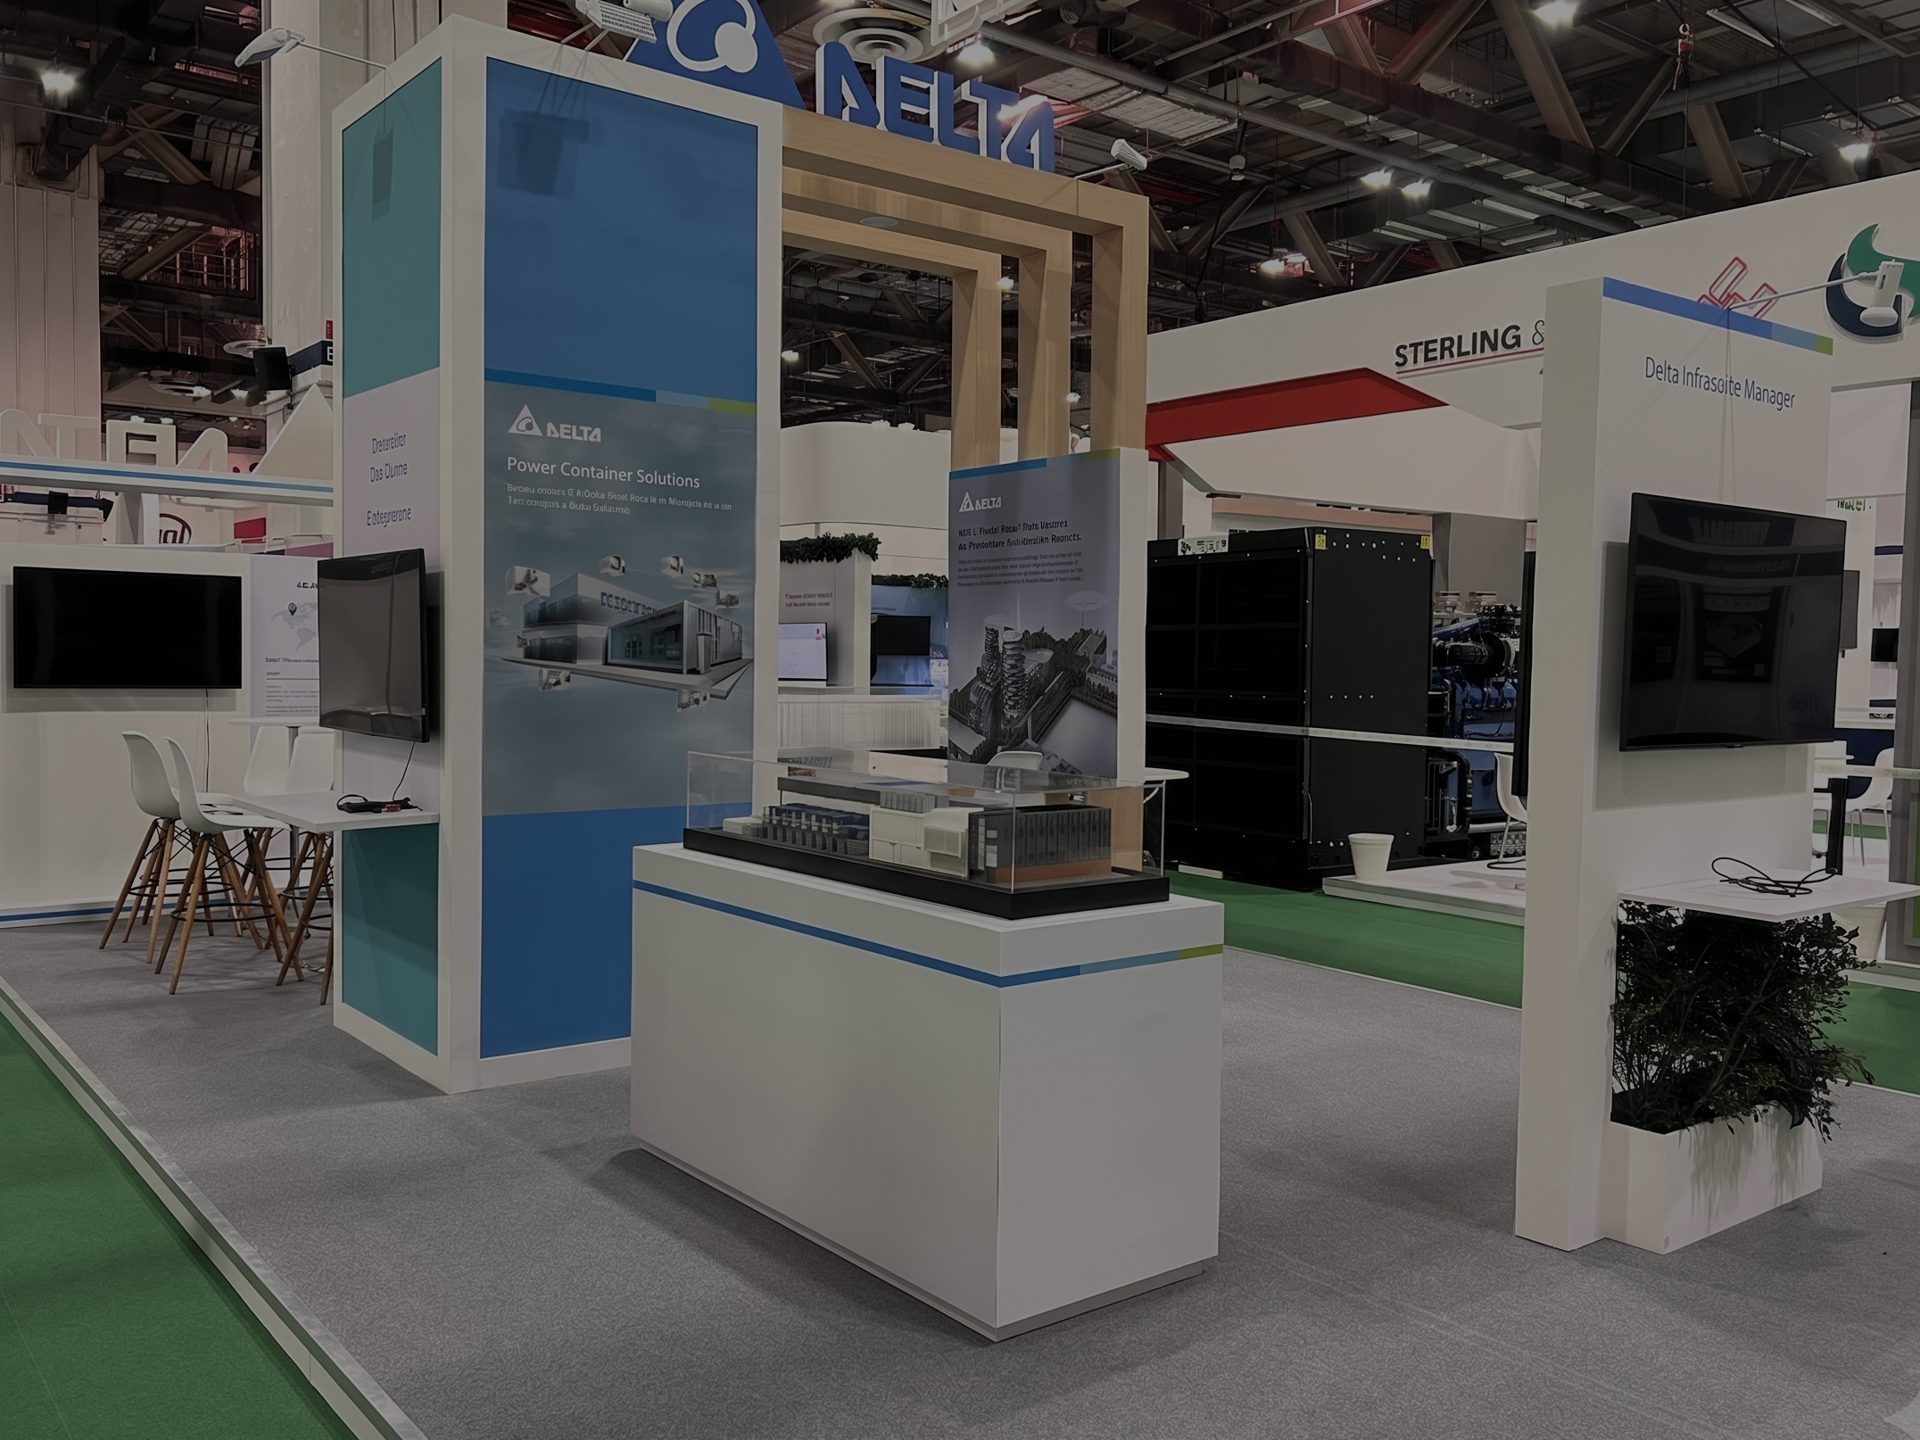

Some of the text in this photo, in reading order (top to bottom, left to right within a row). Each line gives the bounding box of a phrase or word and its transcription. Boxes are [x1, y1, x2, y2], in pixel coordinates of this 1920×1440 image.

[815, 40, 1057, 174] DELTA
[1394, 324, 1521, 368] STERLING
[1644, 356, 1679, 384] Delta
[1744, 378, 1796, 411] Manager
[546, 421, 602, 443] DELTA
[507, 456, 700, 488] Power Container Solutions
[975, 496, 1002, 511] DELTA
